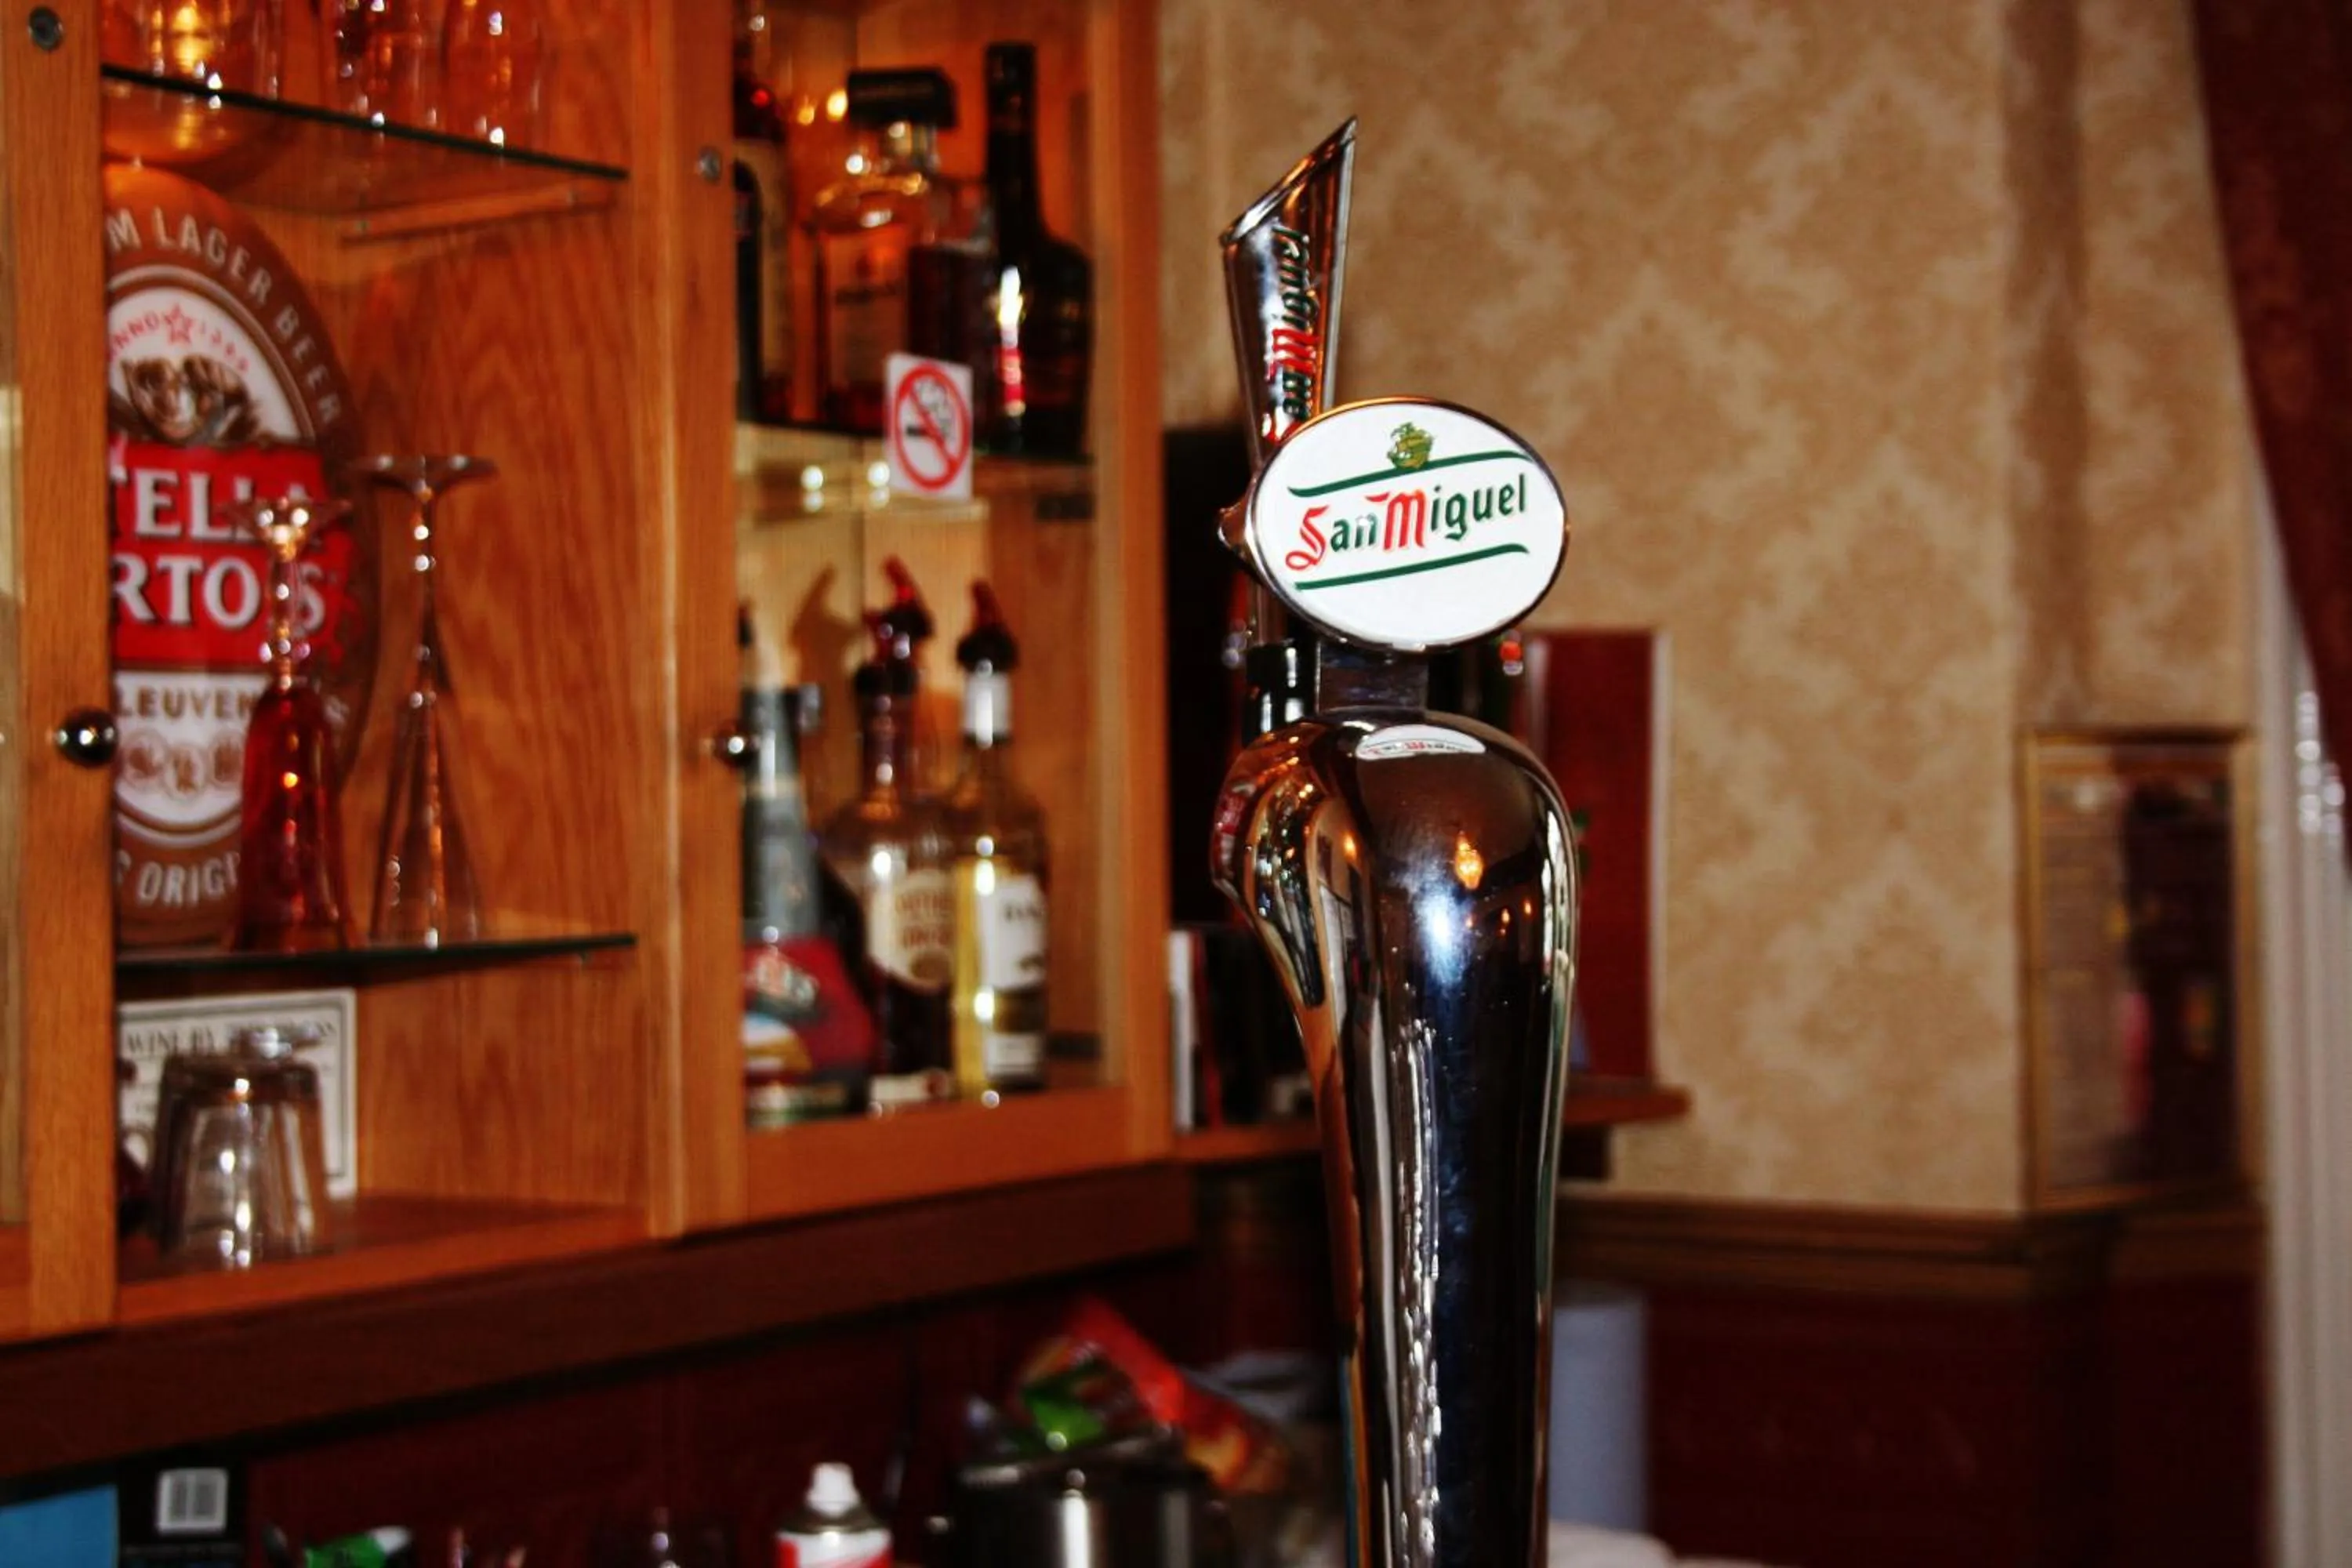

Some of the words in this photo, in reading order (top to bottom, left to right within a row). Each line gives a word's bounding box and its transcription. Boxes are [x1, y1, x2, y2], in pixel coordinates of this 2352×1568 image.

[152, 207, 272, 305] LAGER
[275, 304, 341, 423] BEER
[1285, 504, 1378, 571] San
[1366, 473, 1526, 550] Miguel
